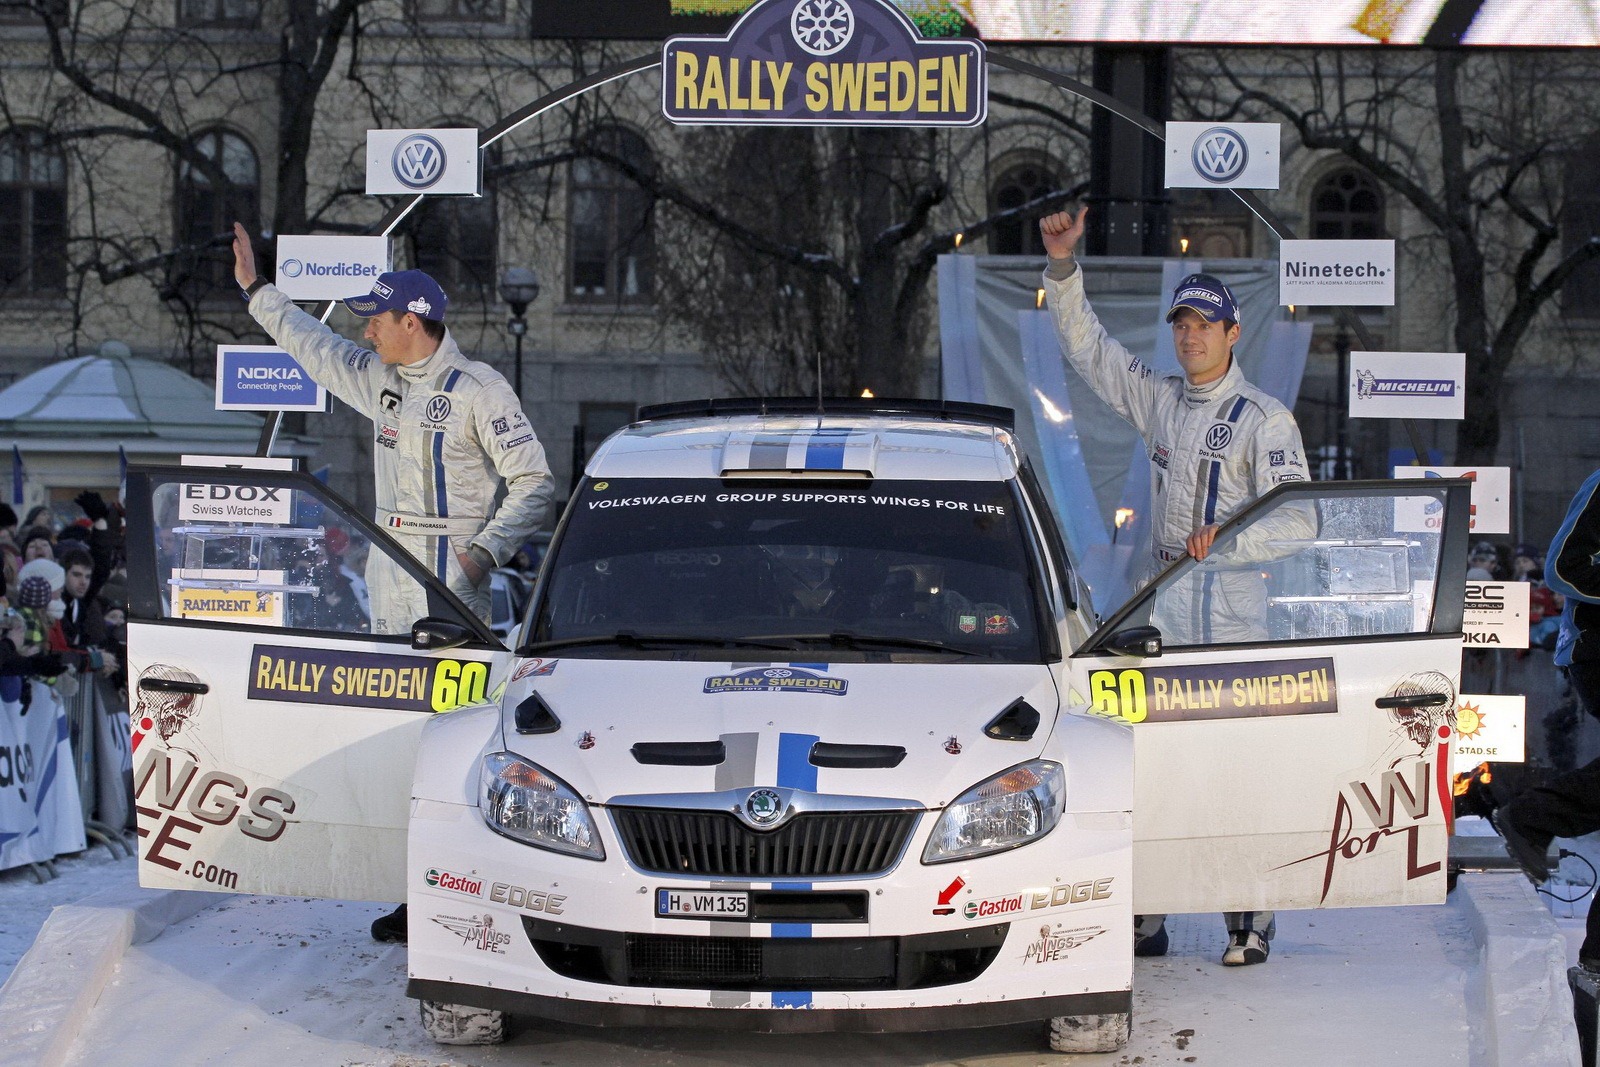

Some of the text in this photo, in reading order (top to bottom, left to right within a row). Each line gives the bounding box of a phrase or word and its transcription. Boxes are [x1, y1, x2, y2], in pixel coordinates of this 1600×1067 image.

[675, 50, 969, 114] RALLY SWEDEN
[306, 261, 377, 277] NordicBet
[1286, 261, 1386, 277] Ninetech.
[1181, 290, 1221, 303] MICHELIN
[237, 366, 302, 380] NOKIA
[237, 381, 303, 392] Connecting People
[1377, 382, 1452, 393] MICHELIN
[1198, 449, 1210, 457] Das
[186, 484, 280, 502] EDOX
[192, 503, 273, 517] Swiss Watches
[588, 493, 1005, 515] VOLKSWAGEN GROUP SUPPORTS WINGS FOR LIFE
[183, 599, 250, 612] RAMIRENT
[256, 654, 488, 713] RALLY SWEDEN 60
[710, 677, 842, 690] RALLY SWEDEN
[1091, 667, 1329, 723] 60 RALLY SWEDEN
[184, 860, 239, 890] .com
[439, 872, 568, 916] Castrol EDGE
[978, 876, 1115, 917] Castrol EDGE
[670, 895, 747, 913] H VM 135
[472, 927, 511, 945] WINGS
[476, 939, 498, 953] LIFE
[1031, 936, 1074, 953] WINGS
[1036, 949, 1060, 964] LIFE
